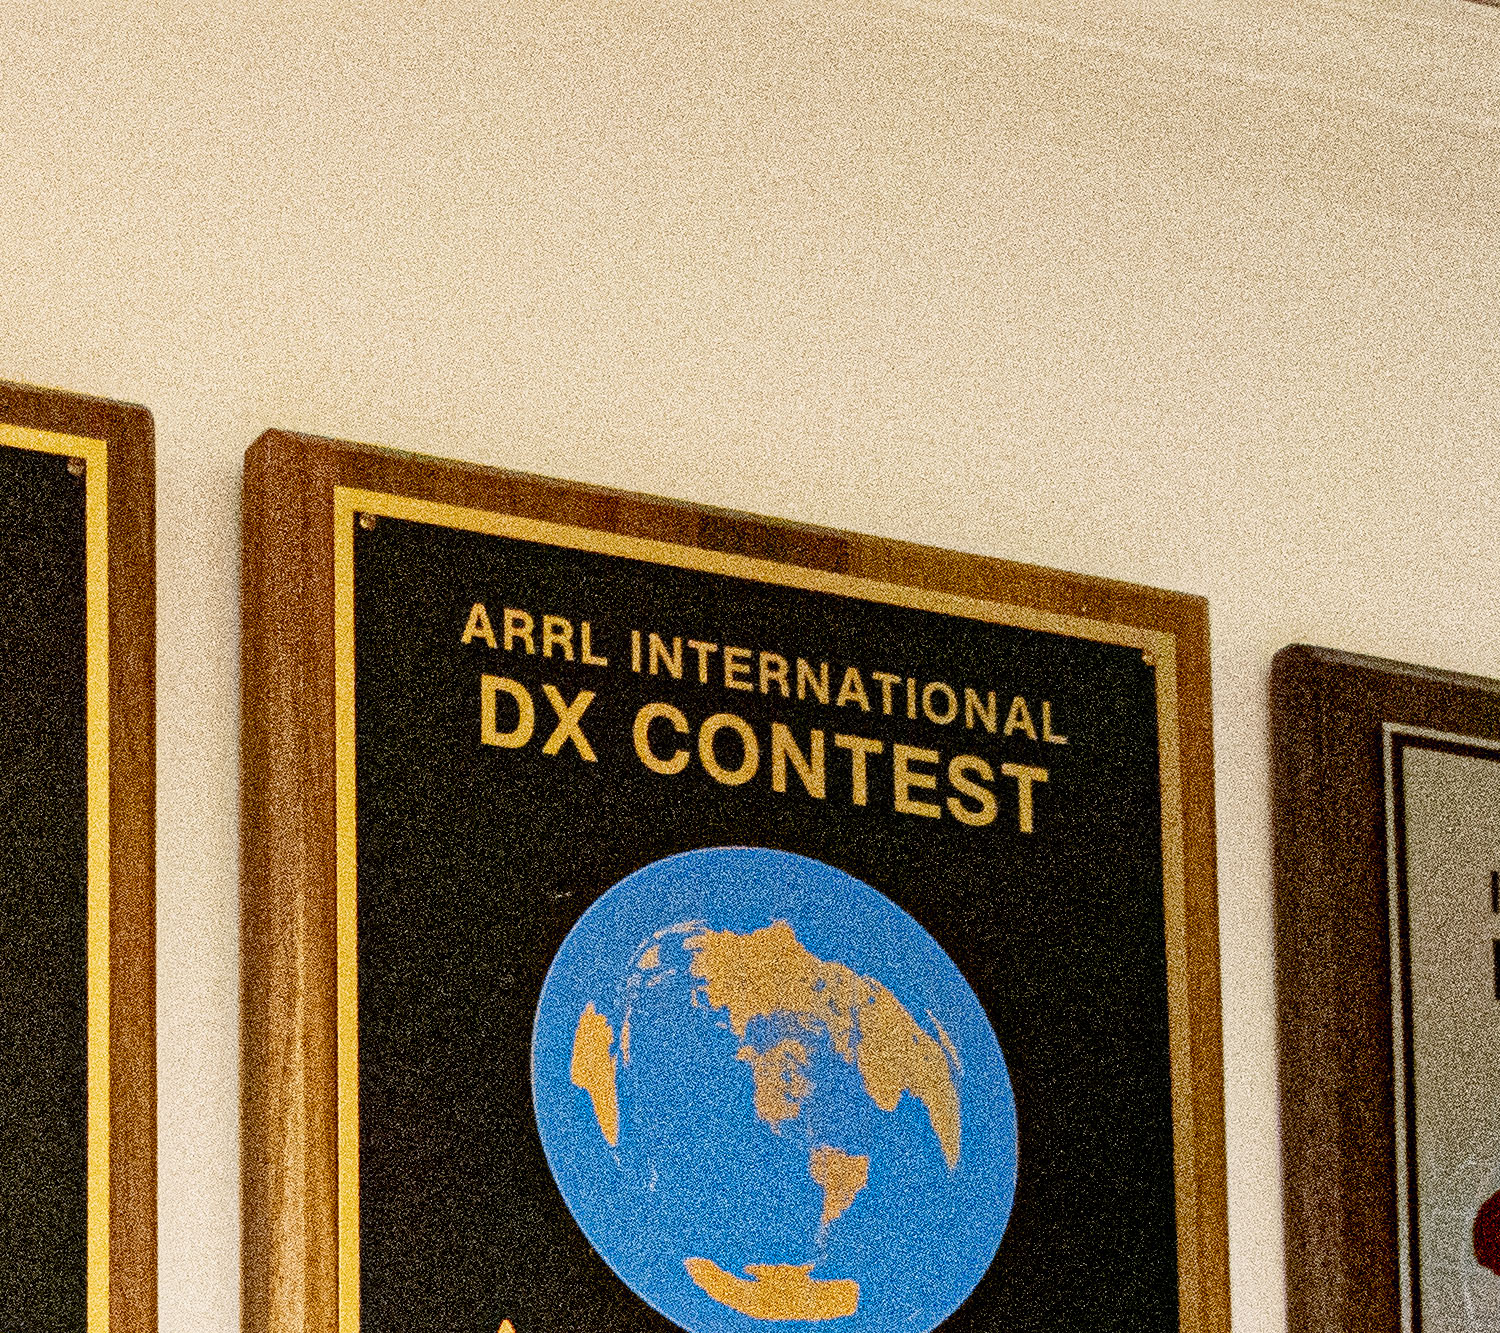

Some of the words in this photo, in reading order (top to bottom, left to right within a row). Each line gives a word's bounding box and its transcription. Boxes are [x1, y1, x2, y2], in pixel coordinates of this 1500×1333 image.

[461, 602, 608, 667] ARRL
[630, 628, 1068, 745] INTERNATIONAL
[479, 673, 598, 763] DX
[632, 701, 1049, 834] CONTEST
